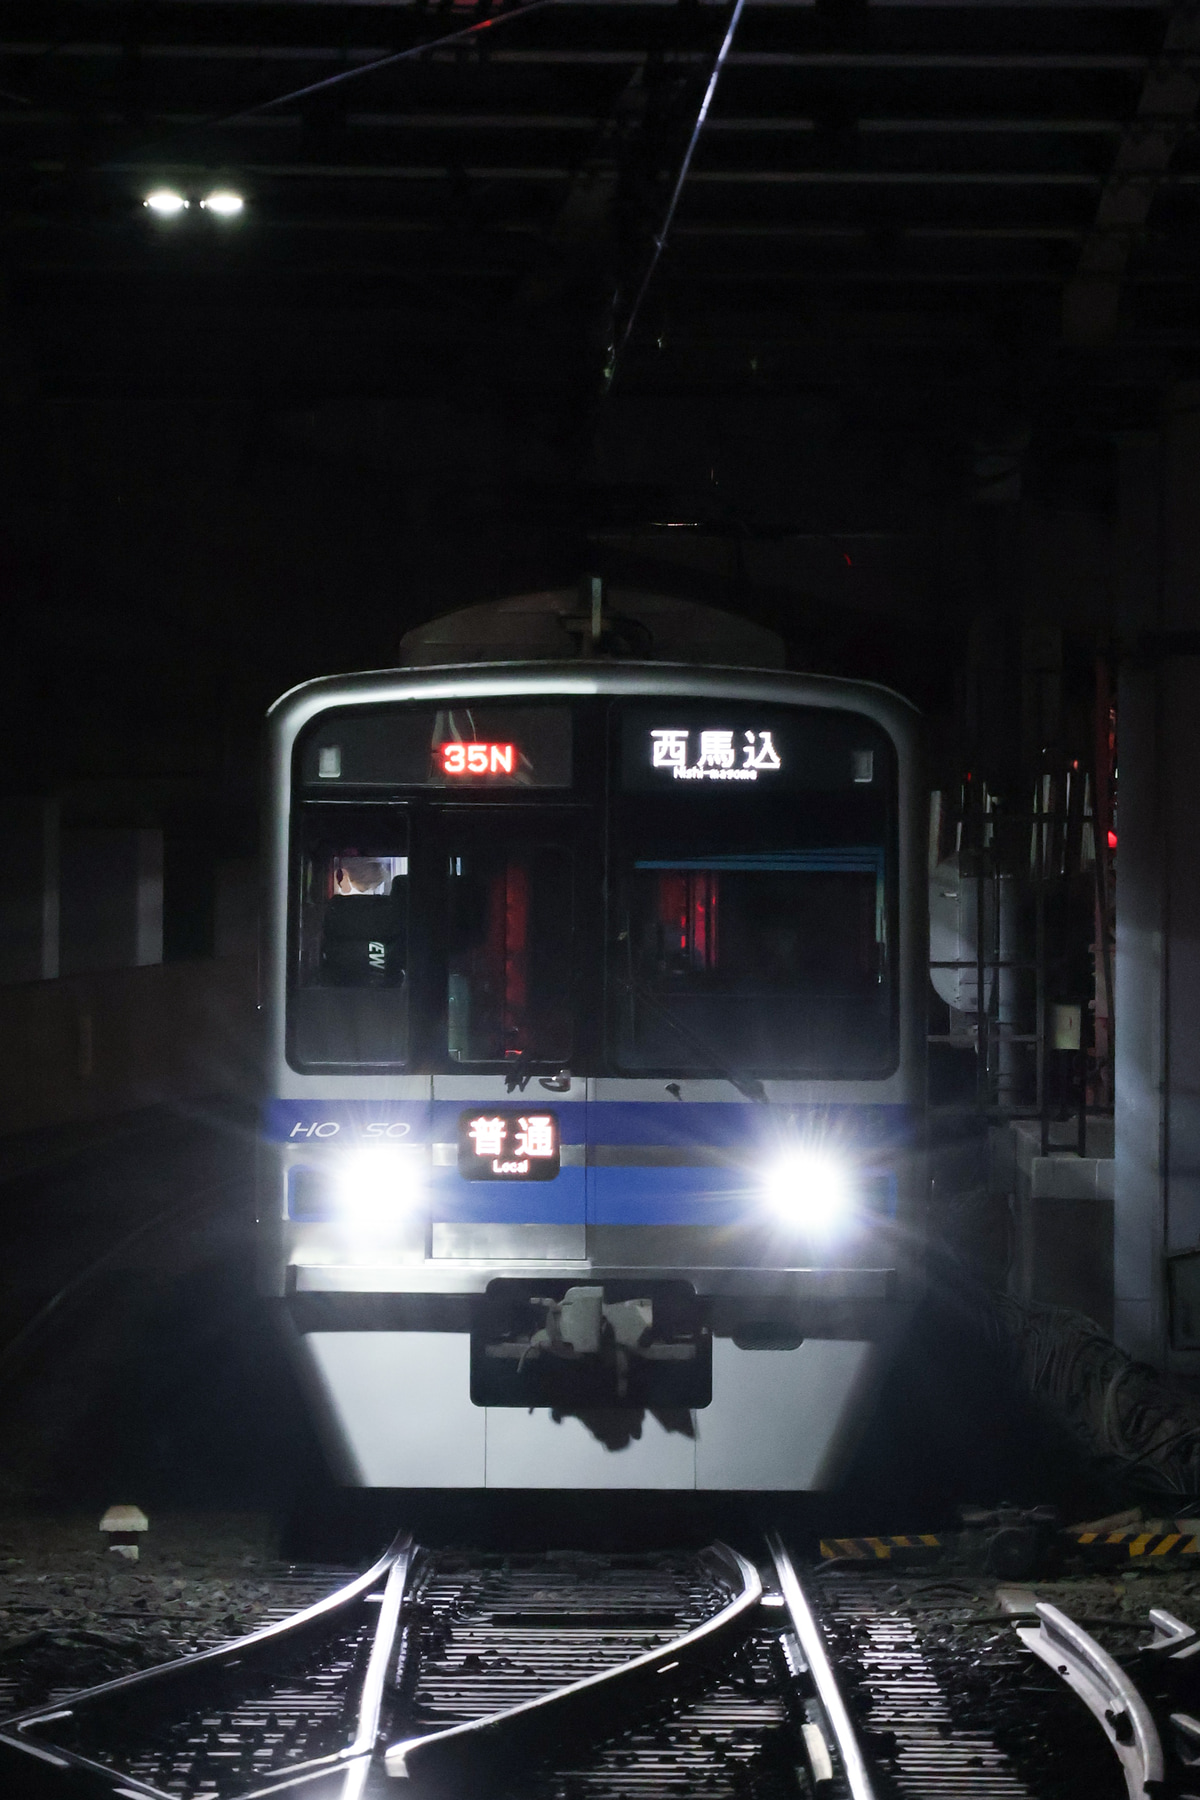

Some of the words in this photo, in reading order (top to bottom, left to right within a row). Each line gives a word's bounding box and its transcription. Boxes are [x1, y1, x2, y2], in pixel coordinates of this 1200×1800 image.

[444, 744, 512, 773] 35N
[650, 730, 781, 769] 西馬込
[468, 1116, 554, 1156] 普通
[492, 1159, 529, 1174] Local
